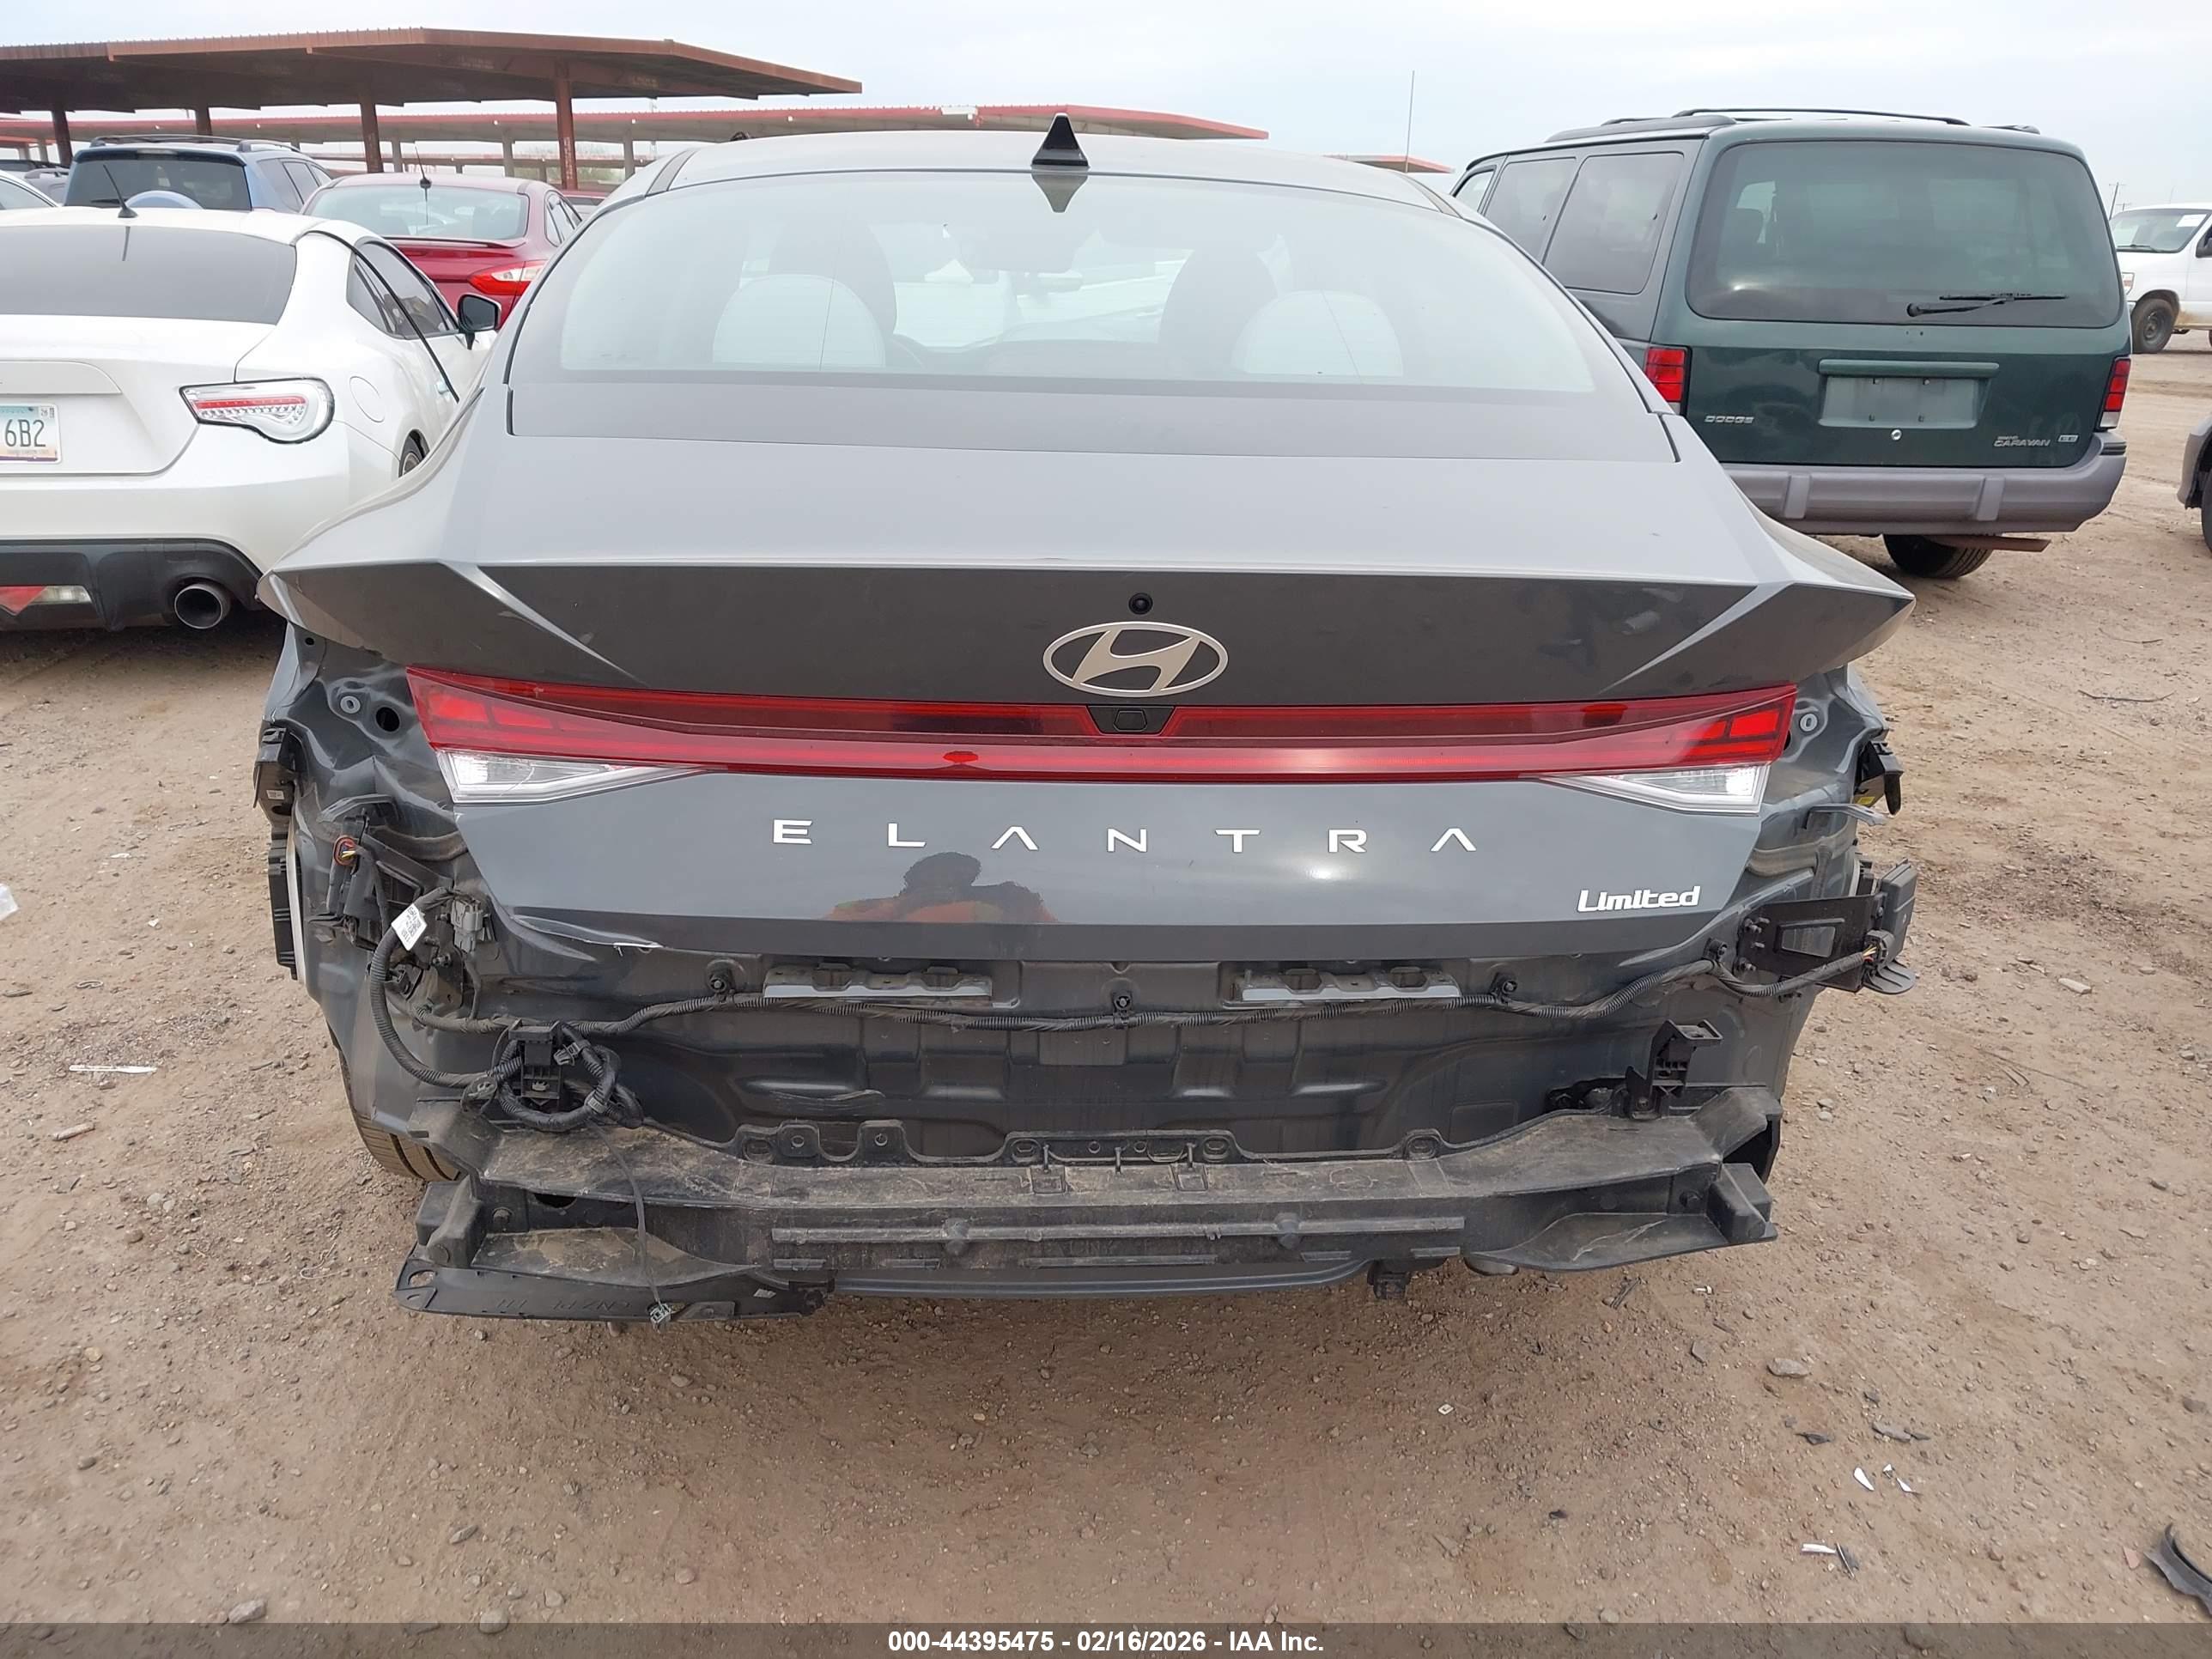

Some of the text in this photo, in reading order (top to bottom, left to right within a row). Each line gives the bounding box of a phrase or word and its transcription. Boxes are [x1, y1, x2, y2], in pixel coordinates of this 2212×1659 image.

[4, 418, 46, 447] 6B2
[1704, 416, 1754, 424] DODGE
[1993, 439, 2051, 447] CARAVAN
[772, 818, 1476, 854] ELANTRA
[1577, 884, 1702, 914] Limited
